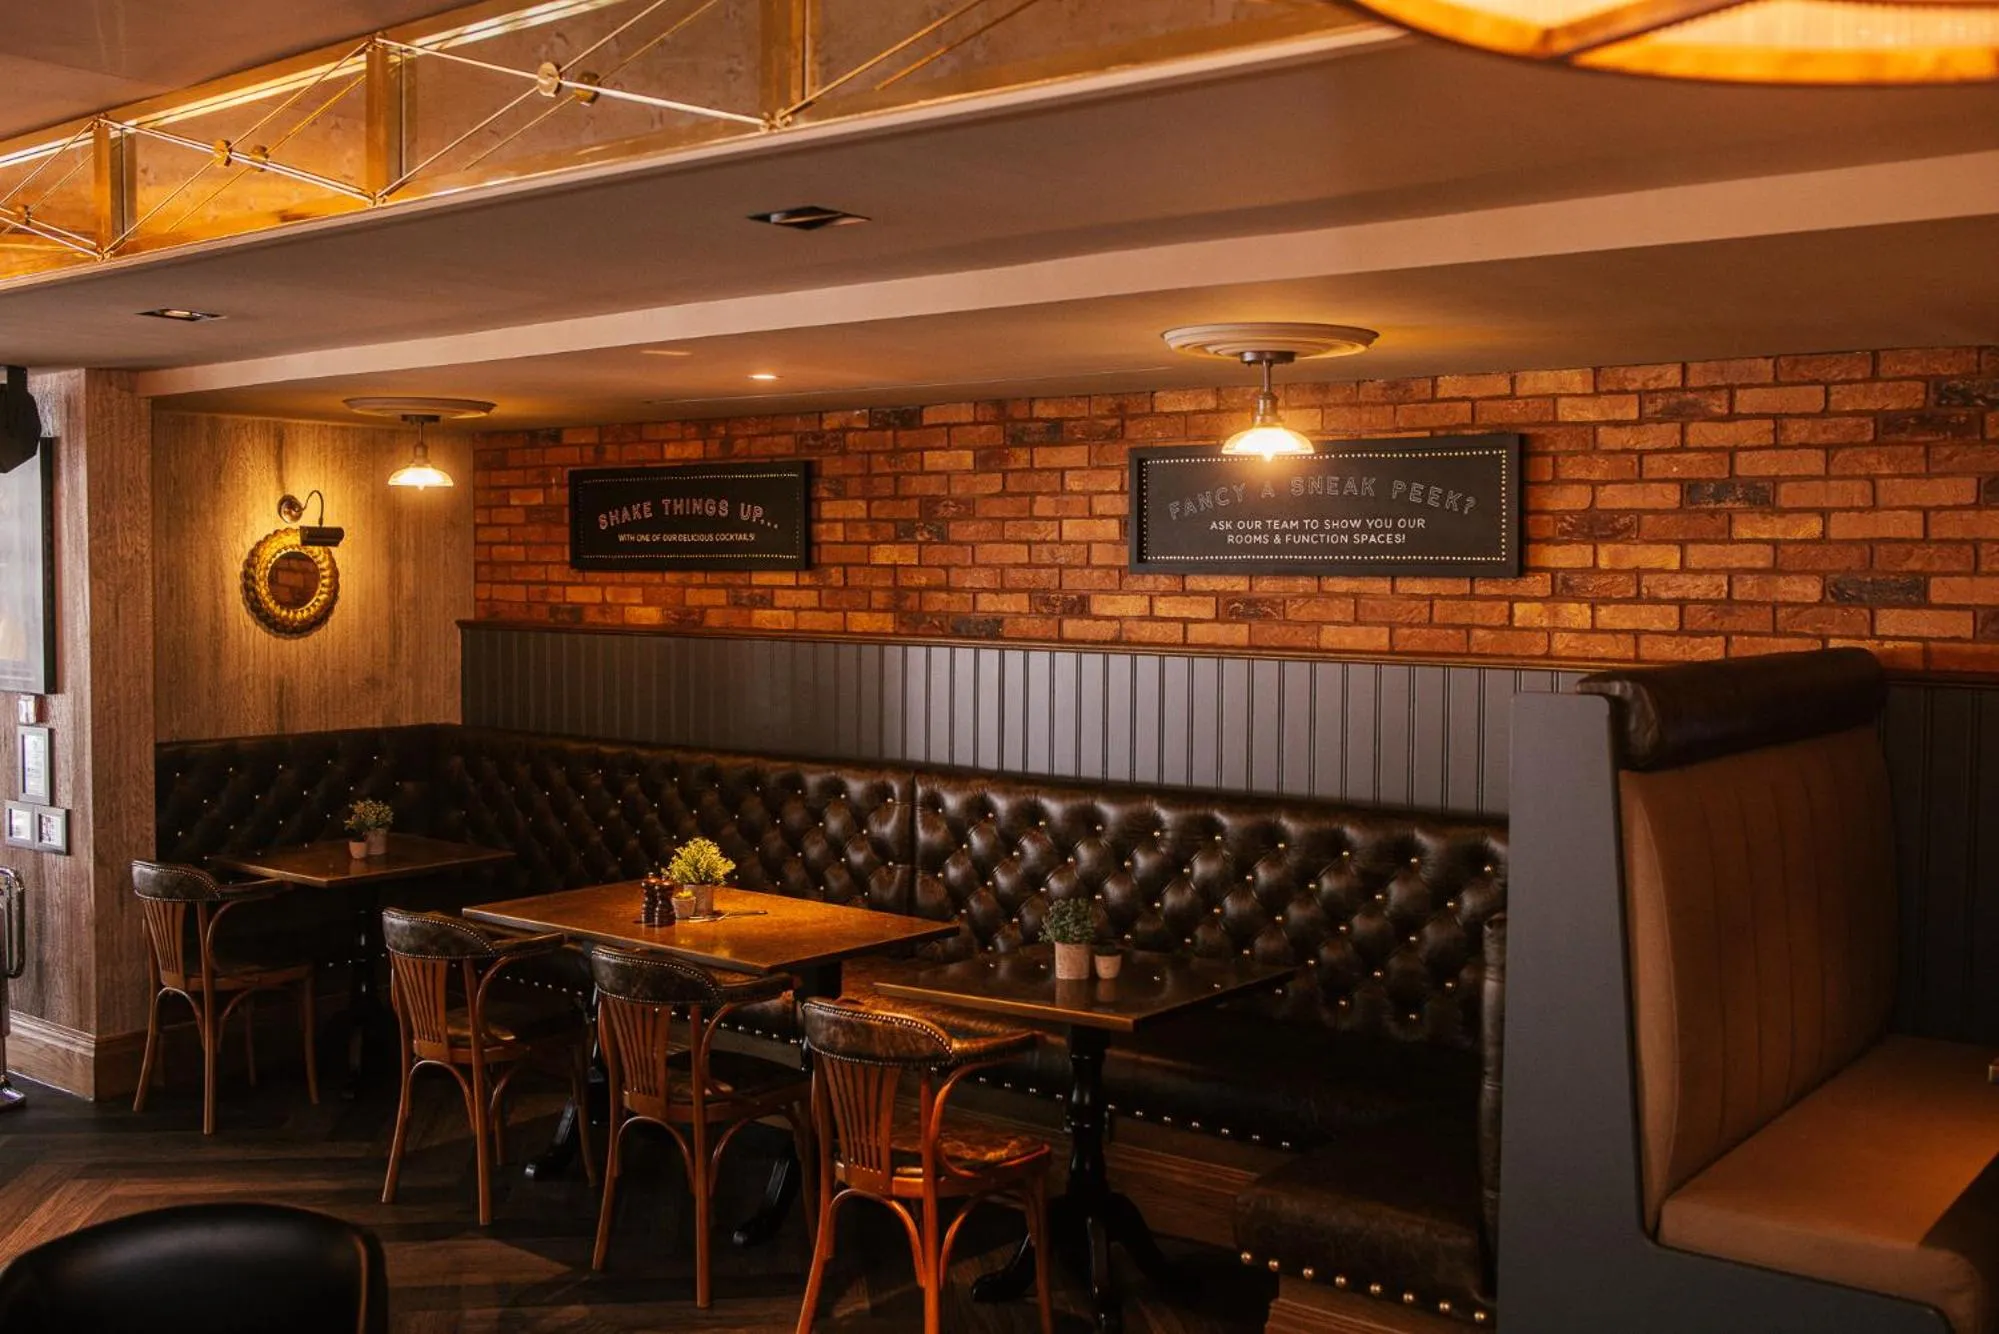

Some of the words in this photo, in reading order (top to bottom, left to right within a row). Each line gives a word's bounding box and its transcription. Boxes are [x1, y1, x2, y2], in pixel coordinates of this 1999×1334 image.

[1168, 483, 1246, 520] FANCY
[1261, 480, 1275, 499] A
[1290, 475, 1377, 497] SNEAK
[1391, 479, 1477, 515] PEEK?
[598, 501, 653, 530] SHAKE
[661, 498, 728, 517] THINGS
[1209, 520, 1234, 531] ASK
[1237, 520, 1263, 531] OUR
[1266, 519, 1299, 531] TEAM
[1303, 519, 1320, 530] TO
[1324, 518, 1362, 530] SHOW
[1366, 518, 1393, 529] YOU
[1397, 517, 1426, 529] OUR
[618, 533, 636, 542] WITH
[651, 533, 661, 542] OF
[1227, 534, 1270, 545] ROOMS
[1273, 534, 1282, 545] &
[1285, 533, 1349, 545] FUNCTION
[1353, 533, 1406, 545] SPACES!
